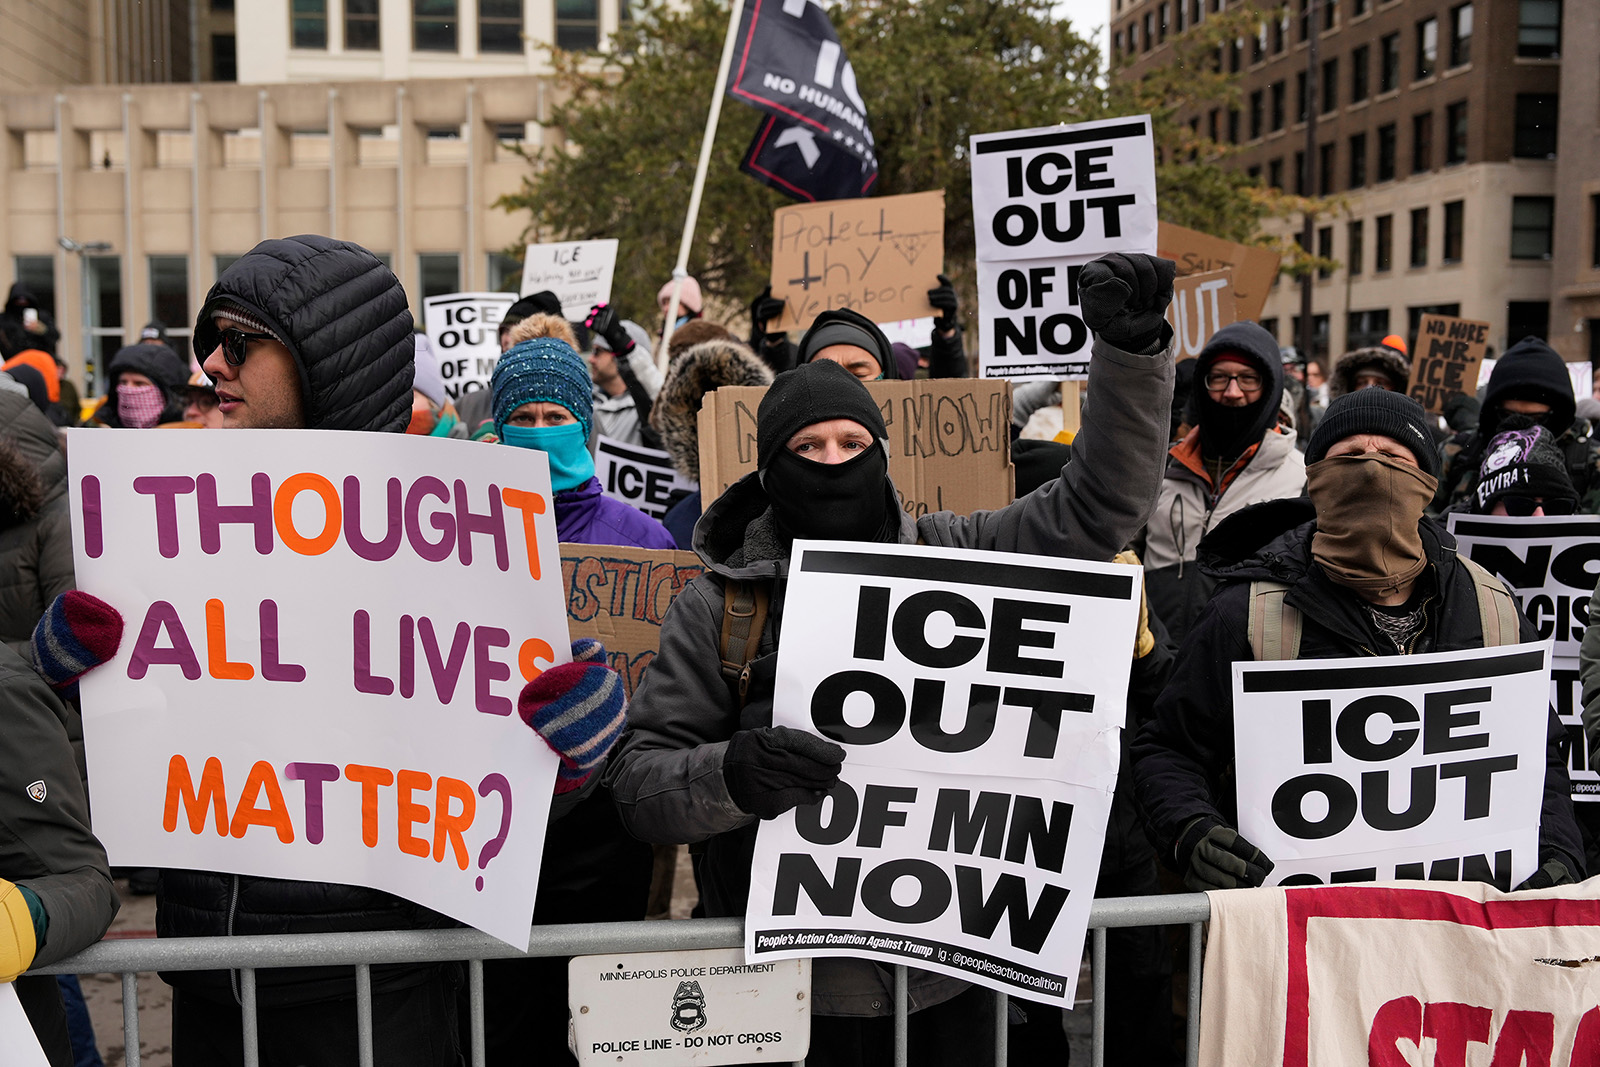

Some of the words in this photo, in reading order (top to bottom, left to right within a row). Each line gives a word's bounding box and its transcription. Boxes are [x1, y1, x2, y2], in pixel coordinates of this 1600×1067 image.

[763, 72, 797, 94] NO
[798, 84, 864, 131] HUMAN
[1006, 145, 1116, 198] ICE
[779, 208, 894, 252] Protect
[992, 193, 1136, 247] OUT
[553, 246, 582, 266] ICE
[997, 266, 1056, 311] OF
[445, 306, 501, 326] ICE
[993, 312, 1096, 357] NO
[1425, 320, 1446, 336] NO
[1448, 321, 1489, 344] MORE
[441, 359, 469, 379] OF
[476, 359, 496, 376] M
[1429, 337, 1477, 362] MR.
[444, 380, 493, 400] NO
[1416, 357, 1466, 390] ICE
[608, 460, 675, 507] ICE
[1476, 467, 1519, 509] ELVIRA
[80, 474, 104, 559] I
[132, 472, 546, 581] THOUGHT
[852, 585, 1072, 679] ICE
[127, 598, 307, 683] ALL
[352, 609, 556, 718] LIVES
[810, 669, 1096, 760] OUT
[1302, 686, 1492, 765] ICE
[1271, 753, 1518, 840] OUT
[162, 753, 513, 892] MATTER?
[794, 779, 919, 849] OF
[927, 787, 1075, 875] MN
[771, 853, 1071, 956] NOW
[599, 969, 668, 982] MINNEAPOLIS
[670, 967, 706, 979] POLICE
[709, 963, 777, 976] DEPARTMENT
[757, 933, 795, 949] People's
[795, 933, 825, 946] Action
[825, 933, 867, 945] Coalition
[867, 935, 903, 951] Against
[903, 938, 934, 958] Trump
[937, 948, 948, 963] ig
[952, 952, 1063, 992] @peoplesactioncoalition
[592, 1040, 640, 1054] POLICE
[643, 1038, 672, 1051] LINE
[684, 1036, 704, 1049] DO
[707, 1034, 734, 1047] NOT
[737, 1031, 782, 1044] CROSS
